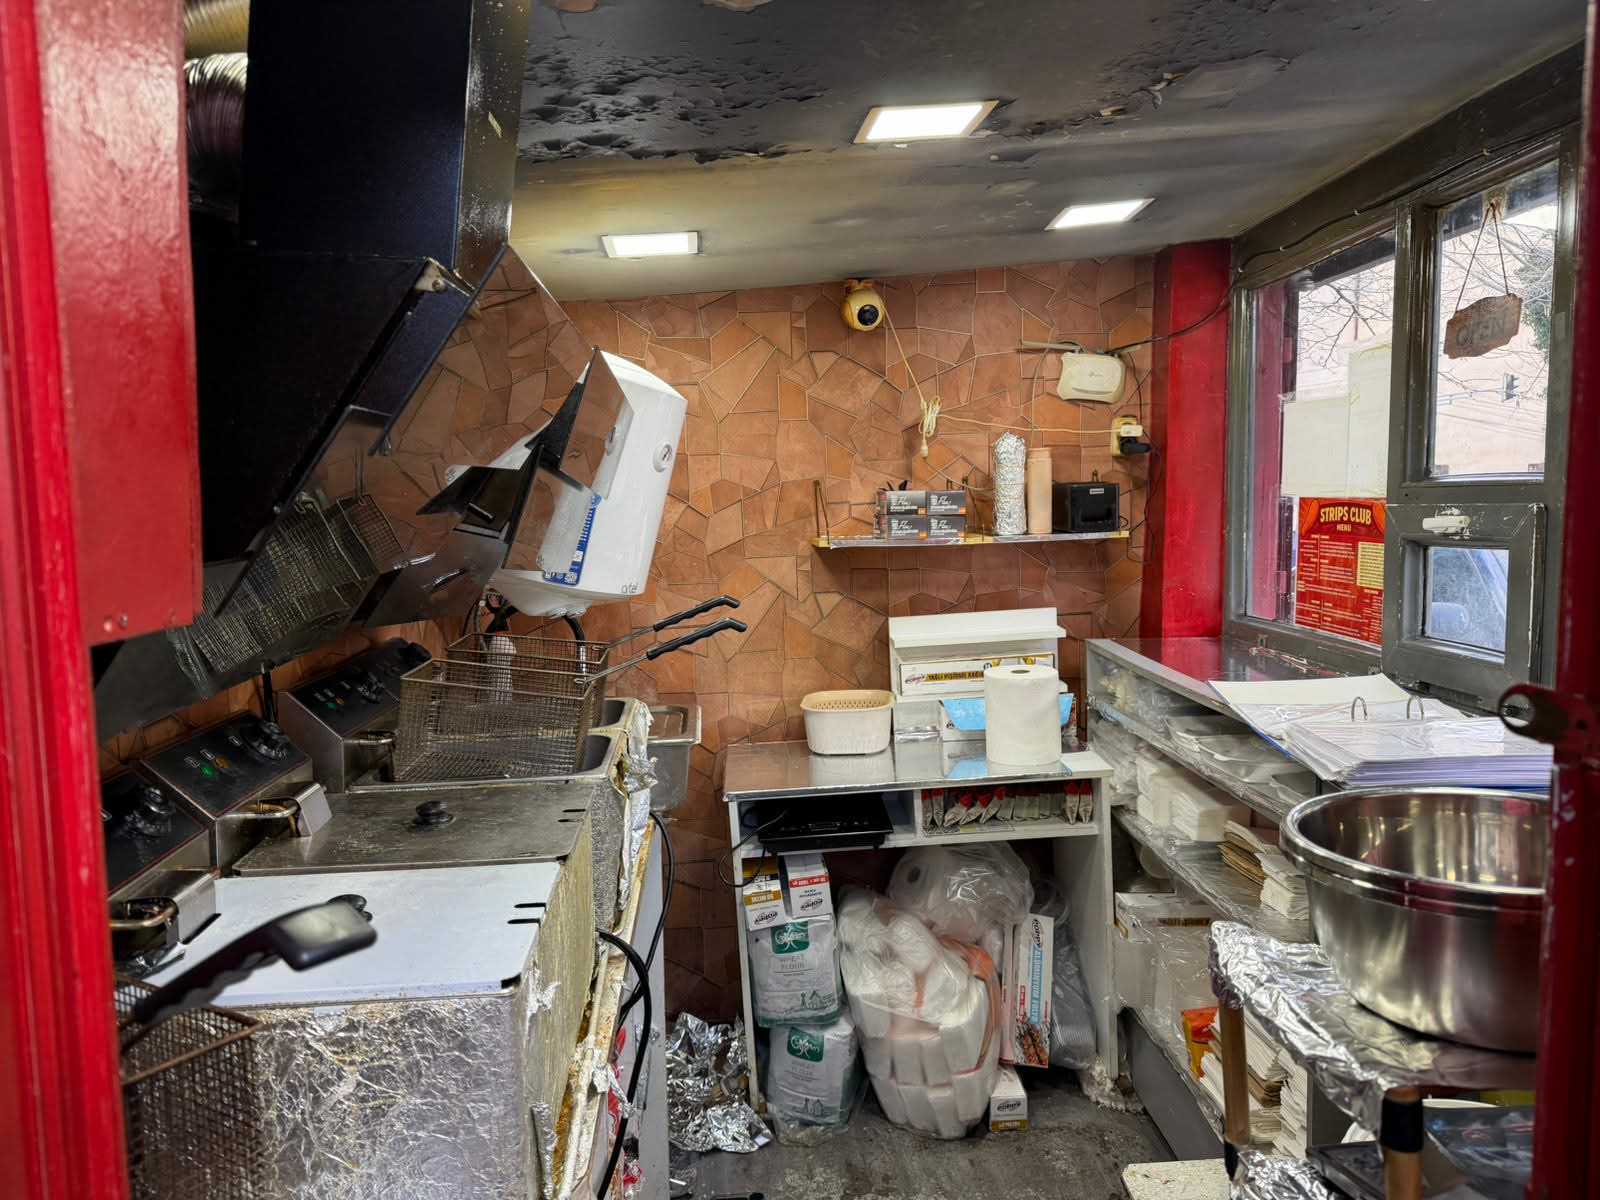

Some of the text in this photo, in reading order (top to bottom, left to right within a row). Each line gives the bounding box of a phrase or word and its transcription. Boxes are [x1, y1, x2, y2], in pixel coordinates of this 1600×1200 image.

[1320, 506, 1372, 525] STRIPS CLUB
[1336, 524, 1352, 532] MENU
[1032, 919, 1041, 948] POPPY
[779, 954, 804, 963] WHEAT
[781, 962, 804, 970] FLOUR
